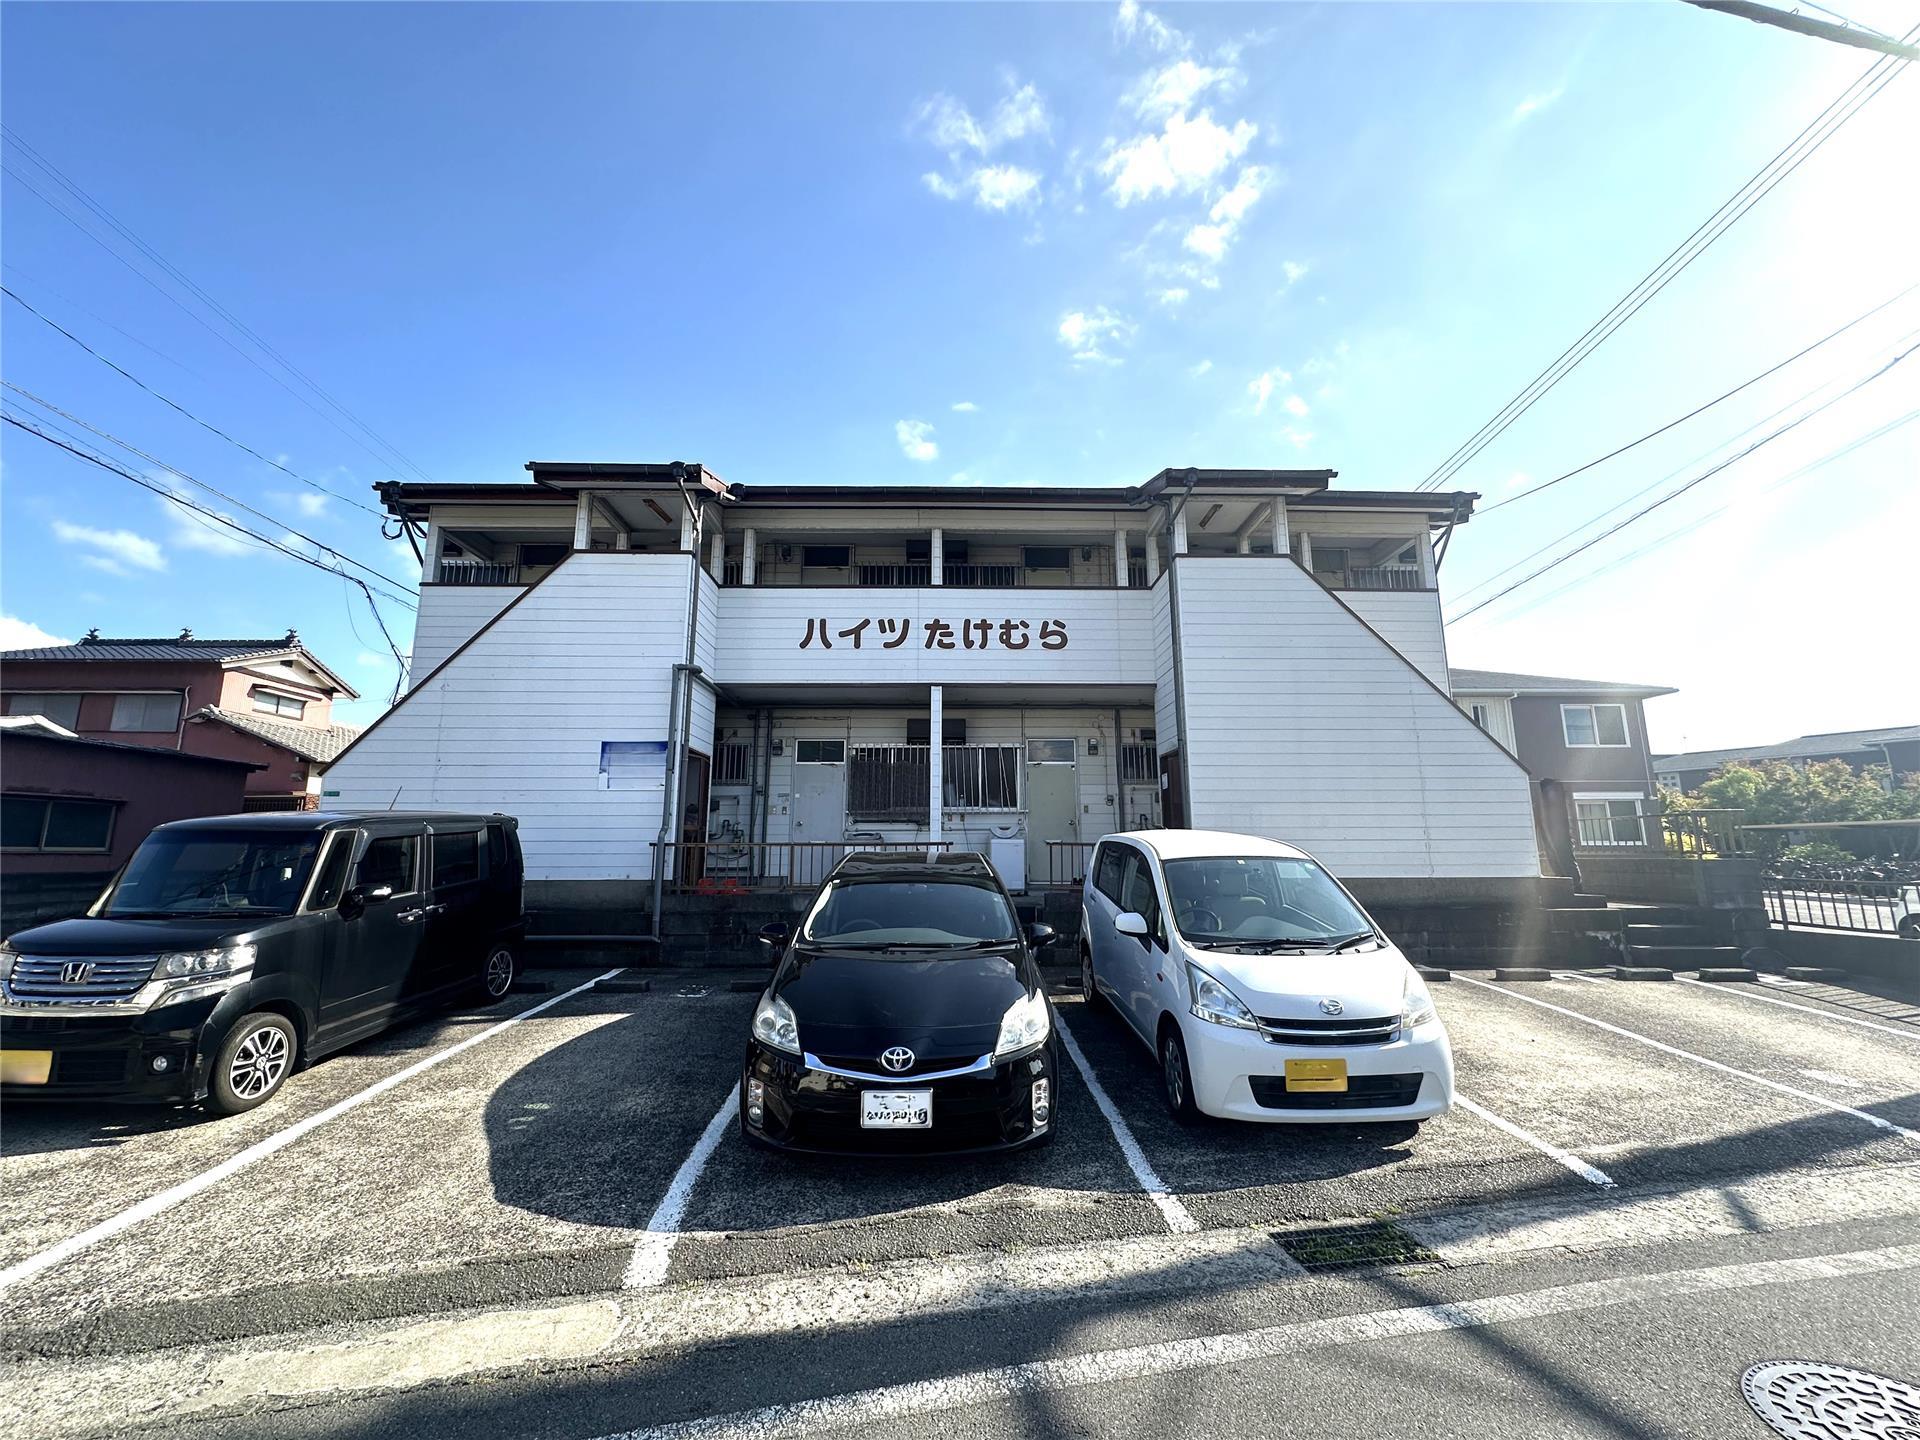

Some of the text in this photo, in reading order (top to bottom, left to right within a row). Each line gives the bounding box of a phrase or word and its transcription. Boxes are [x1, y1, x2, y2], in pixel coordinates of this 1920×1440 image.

[798, 618, 1069, 651] ハイツ たけむら
